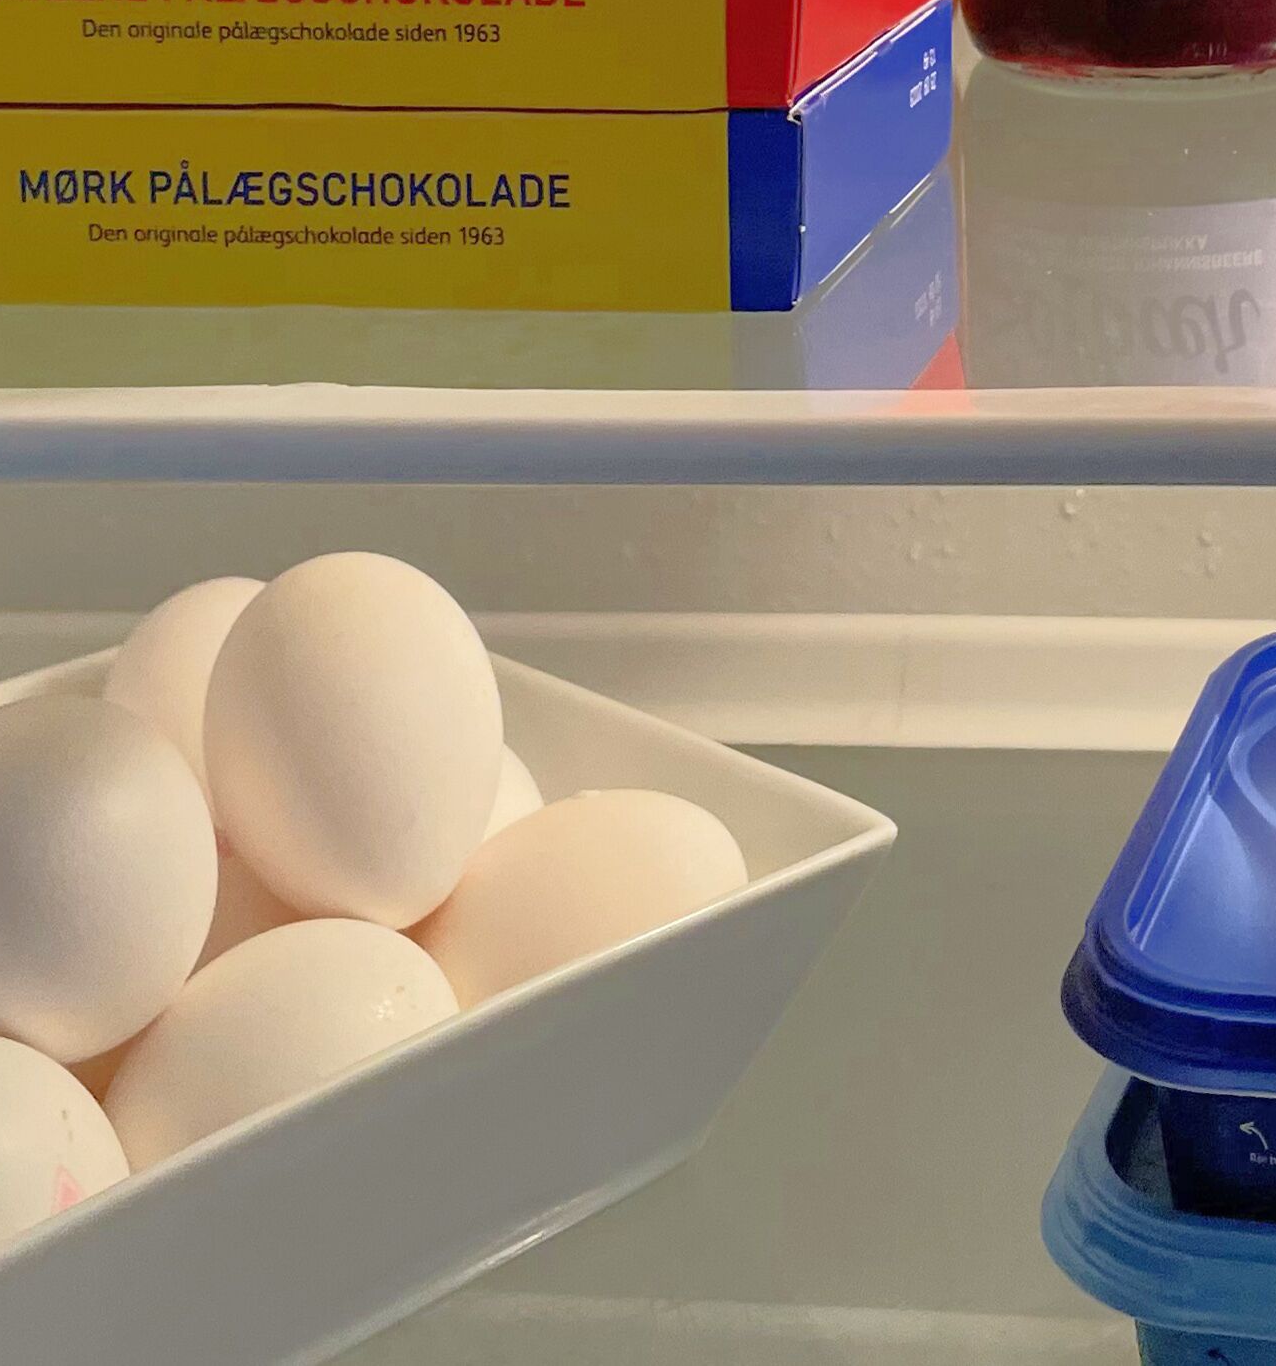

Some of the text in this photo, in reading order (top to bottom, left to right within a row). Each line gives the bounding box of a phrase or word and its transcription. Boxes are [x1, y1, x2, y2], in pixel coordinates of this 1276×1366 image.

[81, 18, 501, 45] Den originale pålægschokolade siden 1963
[19, 159, 572, 209] MØRK PÅLÆGSCHOKOLADE
[88, 222, 506, 249] Den originale pålægschokolade siden 1963
